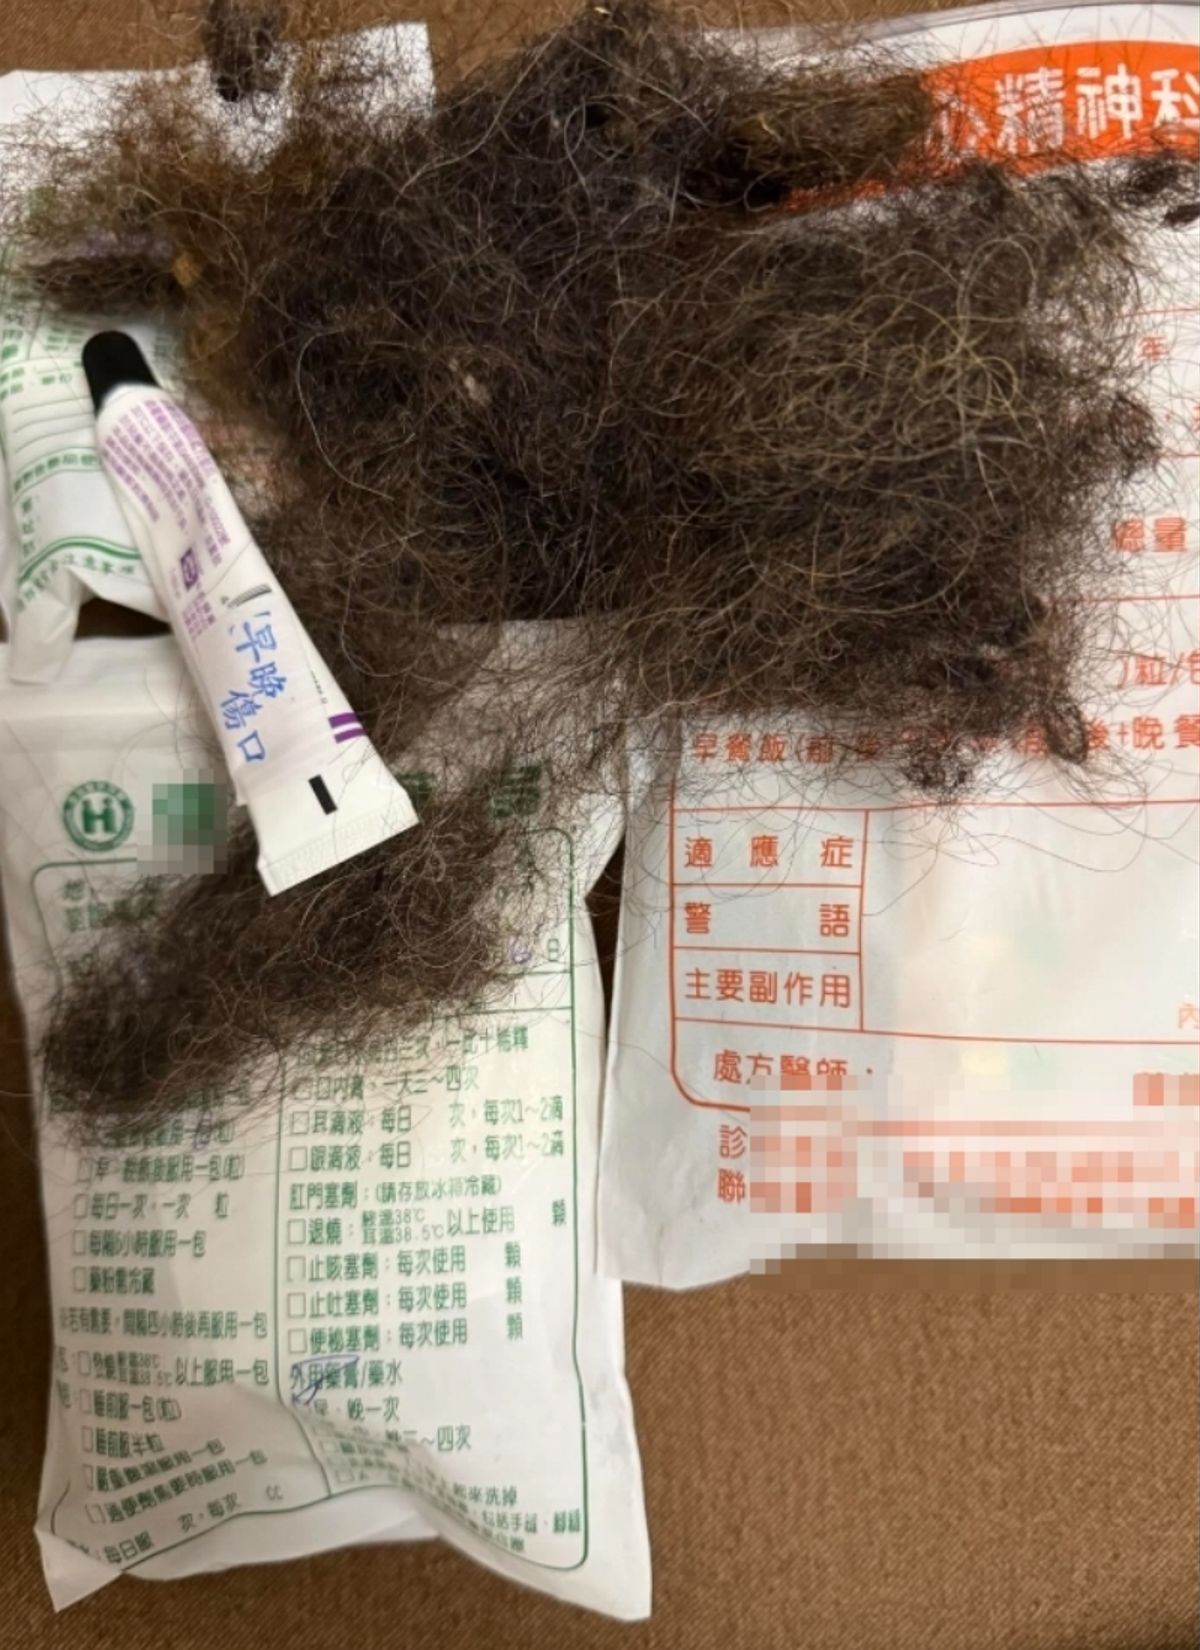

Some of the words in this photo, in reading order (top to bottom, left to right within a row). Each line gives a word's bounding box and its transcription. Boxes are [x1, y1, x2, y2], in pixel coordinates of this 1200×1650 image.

[684, 834, 854, 869] 適應症
[684, 901, 851, 938] 警語
[685, 967, 852, 1009] 主要副作用
